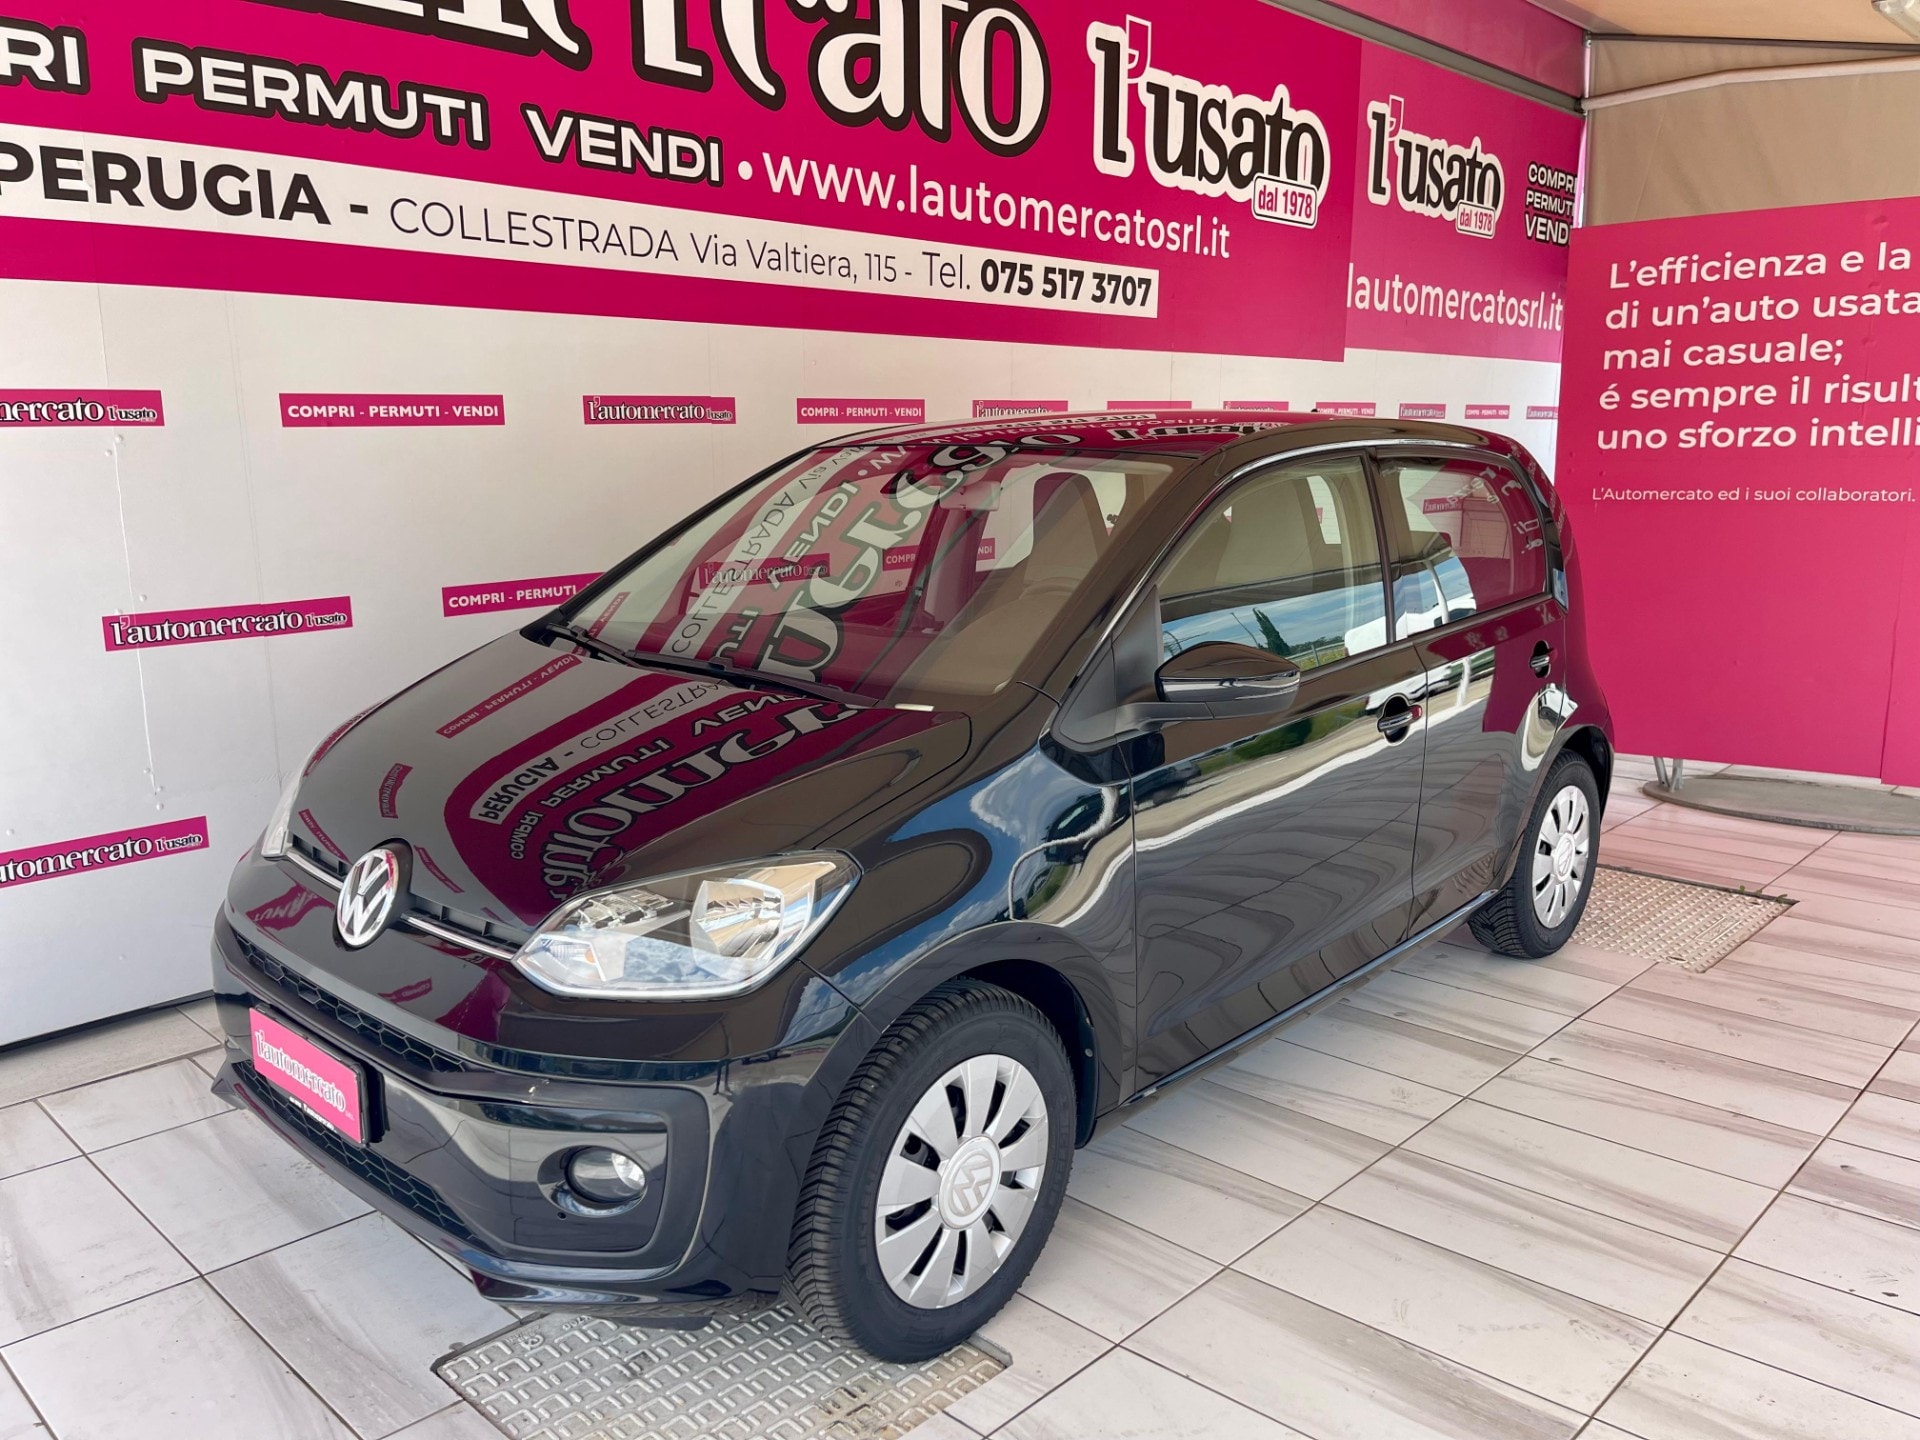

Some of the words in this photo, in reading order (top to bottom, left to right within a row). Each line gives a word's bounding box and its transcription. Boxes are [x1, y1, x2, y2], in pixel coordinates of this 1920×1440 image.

[1088, 14, 1330, 198] l'usato
[140, 45, 487, 144] PERMUTI
[523, 107, 722, 184] VENDI
[762, 151, 1231, 260] www.lautomercatosrl.it
[1256, 182, 1279, 212] dal
[1280, 187, 1314, 220] 1978
[0, 140, 332, 226] PERUGIA
[388, 197, 679, 263] COLLESTRADA
[689, 231, 738, 268] Via
[745, 238, 859, 284] Valtiera,
[863, 251, 897, 284] 115
[921, 250, 972, 292] Tel.
[979, 257, 1034, 298] 075
[1040, 265, 1086, 302] 517
[1090, 270, 1153, 309] 3707
[1459, 209, 1473, 229] dal
[1473, 212, 1494, 233] 1978
[1524, 212, 1571, 246] VEND
[1608, 250, 1828, 290] L'efficienza
[1839, 249, 1865, 274] e
[1876, 240, 1912, 272] la
[1604, 300, 1640, 331] di
[1650, 295, 1801, 329] un'auto
[1812, 287, 1920, 319] usata
[1602, 339, 1672, 371] mai
[1681, 332, 1845, 368] casuale;
[287, 405, 356, 419] COMPRI
[368, 404, 441, 418] PERMUTI
[451, 404, 500, 418] VENDI
[586, 395, 706, 421] l'automercato
[800, 406, 839, 418] COMPRI
[845, 406, 889, 417] PERMUTI
[893, 406, 923, 417] VENDI
[1598, 382, 1622, 411] é
[1629, 382, 1778, 415] sempre
[1789, 375, 1811, 406] il
[1596, 426, 1669, 451] uno
[1677, 419, 1798, 450] sforzo
[1591, 486, 1714, 503] L'Automercato
[1717, 486, 1741, 503] ed
[1753, 486, 1792, 502] suoi
[1795, 486, 1917, 504] collaboratori.
[448, 591, 505, 609] COMPRI
[515, 584, 577, 602] PERMUTI
